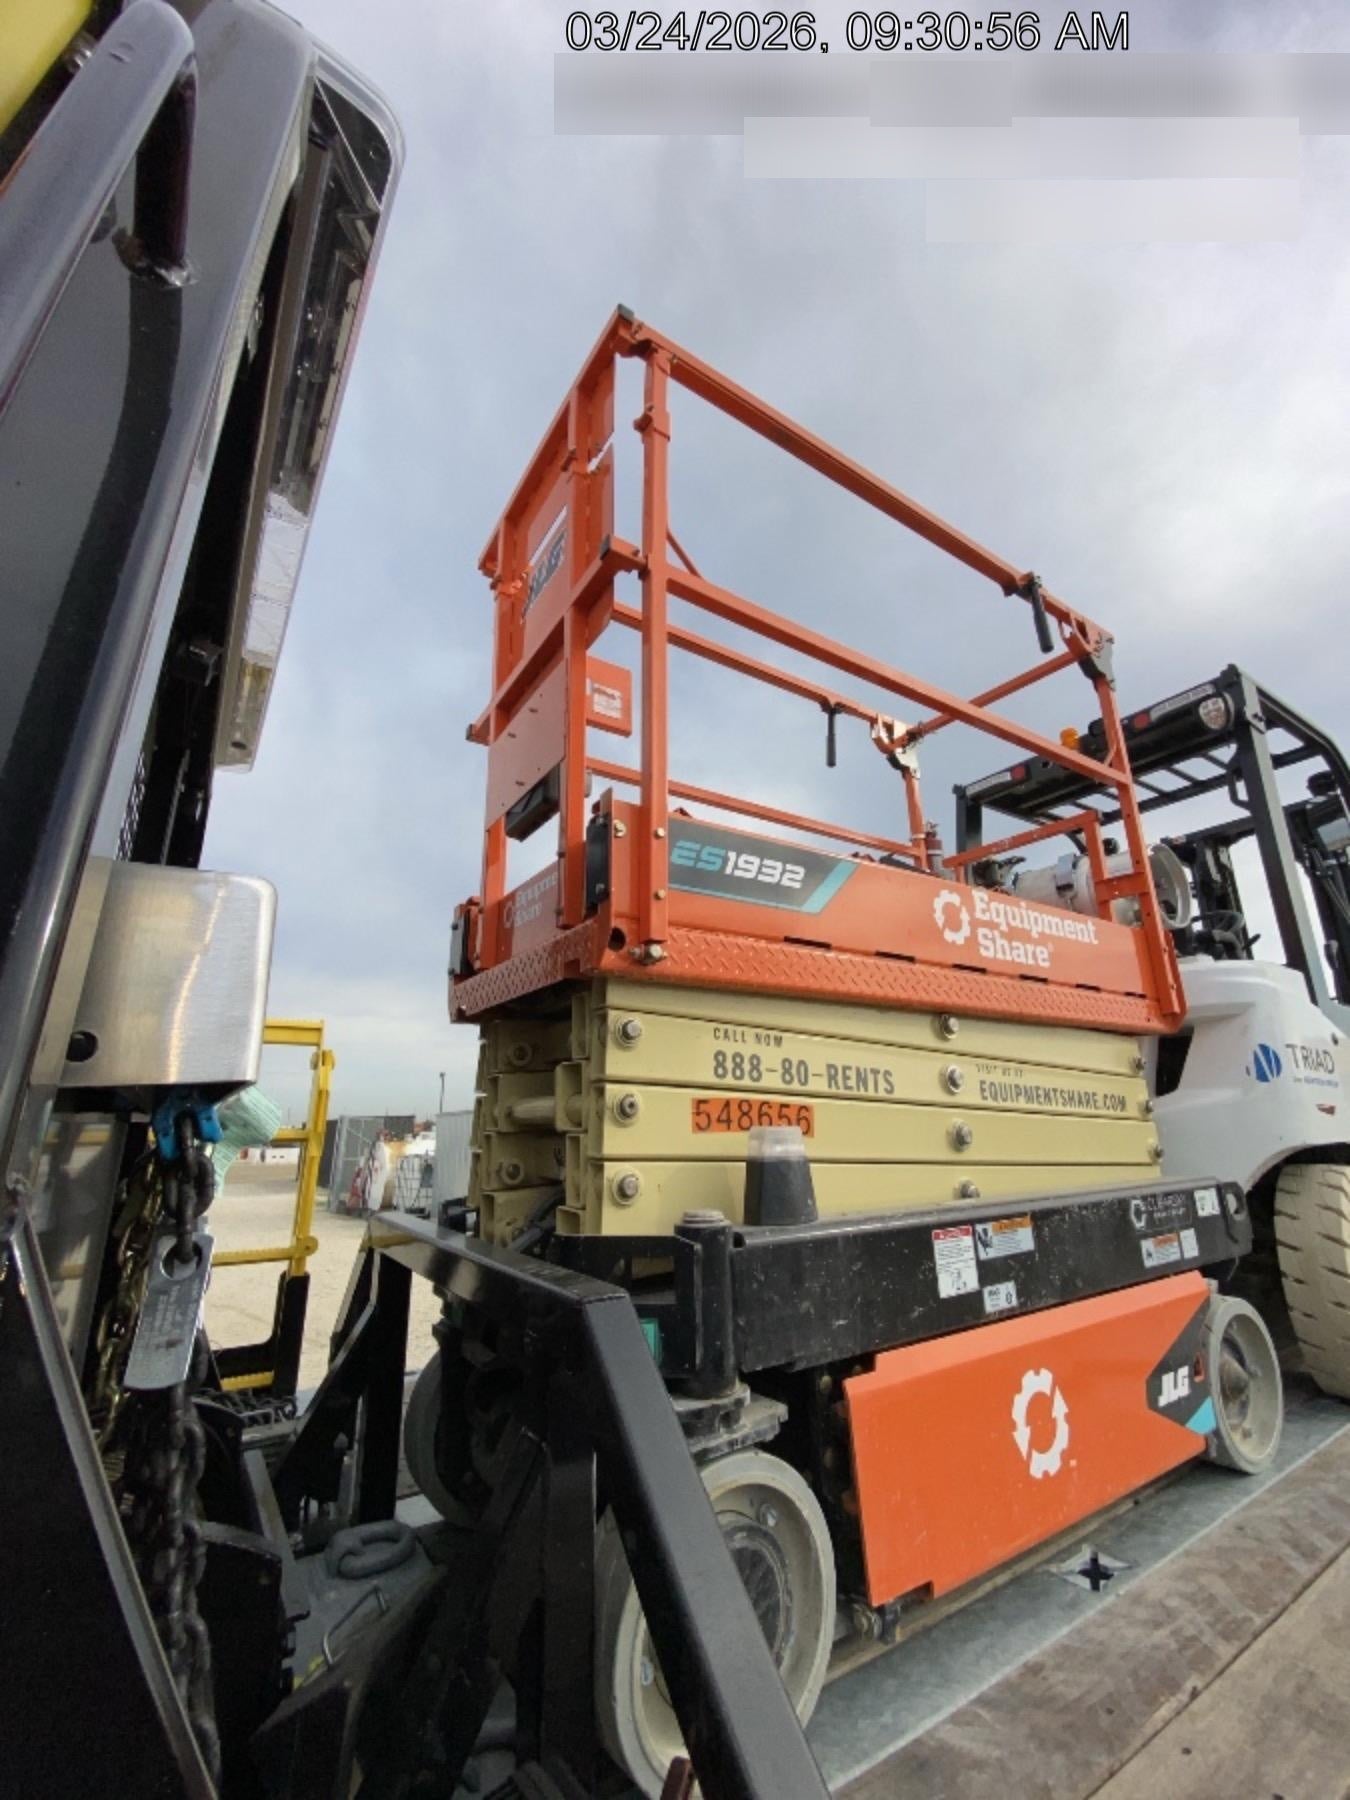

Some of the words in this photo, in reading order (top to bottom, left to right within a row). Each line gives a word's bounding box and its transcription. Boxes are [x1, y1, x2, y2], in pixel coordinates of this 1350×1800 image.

[670, 840, 806, 889] ES1932
[971, 889, 1099, 945] Equipment
[977, 927, 1051, 967] Share
[713, 1026, 747, 1043] CALL
[754, 1031, 783, 1048] NOW
[713, 1049, 895, 1095] 888-80-RENTS
[1284, 1043, 1335, 1074] TRIAD
[979, 1079, 1127, 1113] EQUIPMENTSHARE.COM
[694, 1099, 811, 1136] 548656
[1157, 1365, 1191, 1408] JLG
